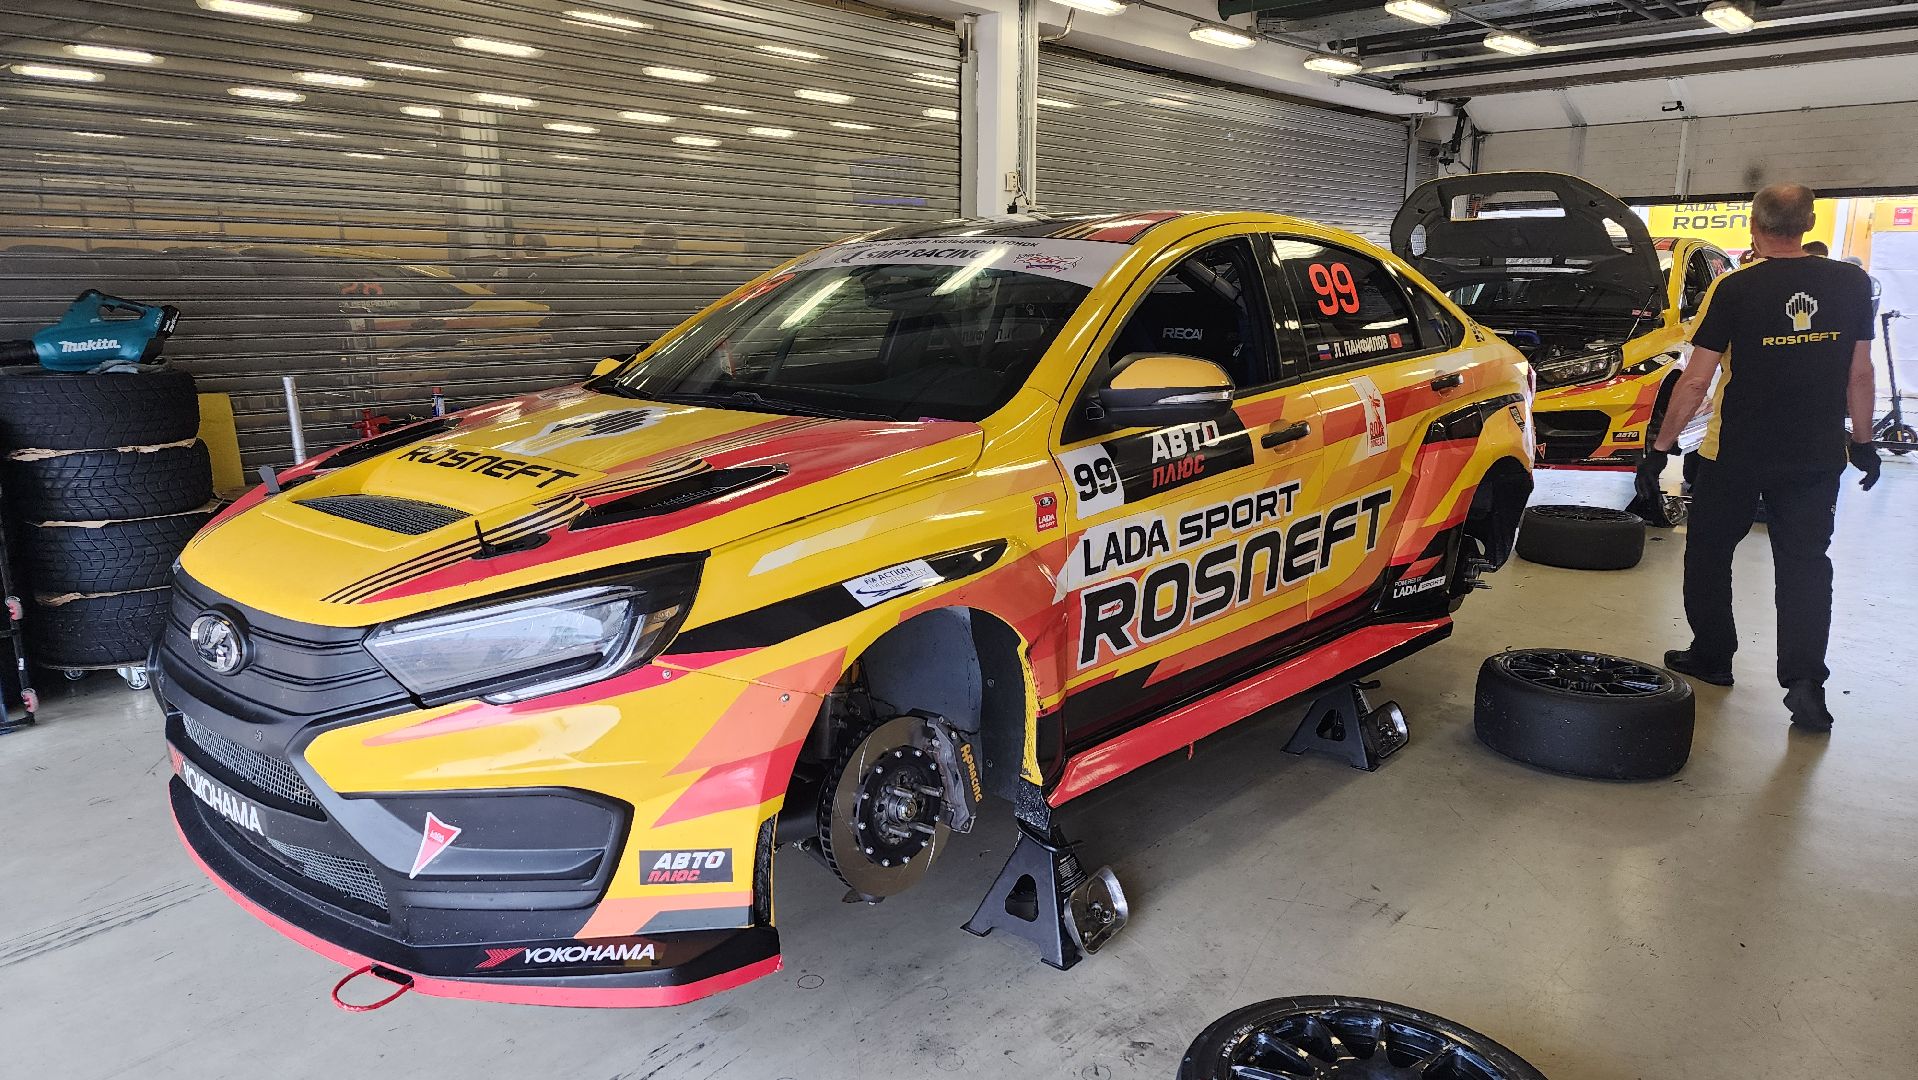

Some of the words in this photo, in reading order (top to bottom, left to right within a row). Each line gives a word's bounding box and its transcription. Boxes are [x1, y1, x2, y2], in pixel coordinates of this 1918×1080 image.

[1308, 262, 1360, 316] 99
[1344, 334, 1389, 357] ПАНФИЛОВ
[1762, 331, 1842, 346] ROSNEFT
[1151, 419, 1221, 465] АВТО
[396, 445, 580, 489] ROSNEFT
[1073, 456, 1119, 502] 99
[1152, 453, 1205, 488] ПЛЮС
[1038, 513, 1056, 525] LADA
[1083, 519, 1170, 579] LADA
[1178, 482, 1301, 548] SPORT
[878, 565, 911, 581] ACTION
[1078, 488, 1392, 669] ROSNEFT
[1393, 584, 1417, 599] LADA
[182, 761, 265, 837] YOKOHAMA
[652, 850, 726, 870] АВТО
[647, 869, 700, 883] ПЛЮС
[523, 944, 655, 964] YOKOHAMA
